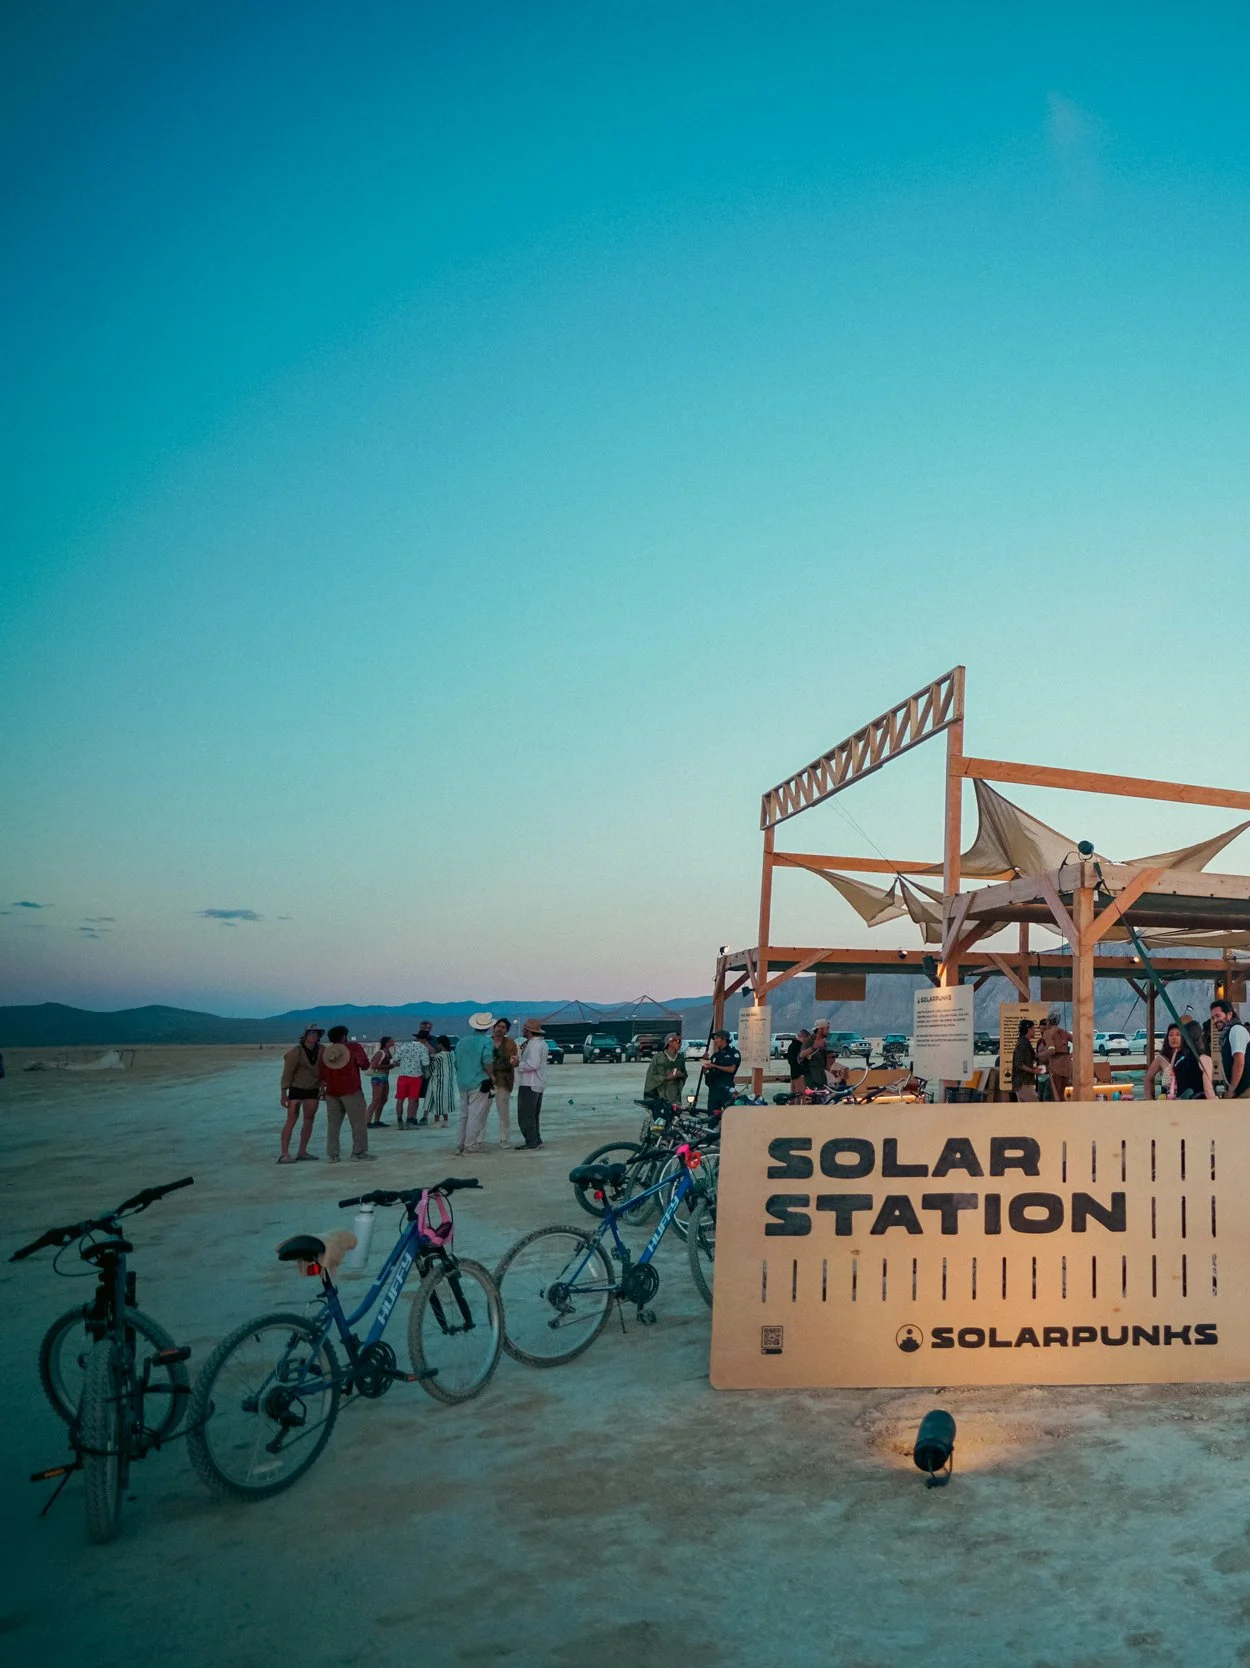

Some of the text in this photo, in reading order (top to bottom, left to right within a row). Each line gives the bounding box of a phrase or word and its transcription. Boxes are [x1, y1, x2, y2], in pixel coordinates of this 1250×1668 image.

[767, 1137, 1041, 1179] SOLAR
[648, 1195, 680, 1253] HUFFY
[765, 1192, 1127, 1236] STATION
[377, 1252, 412, 1326] HUFFY
[931, 1323, 1219, 1348] SOLARPUNKS
